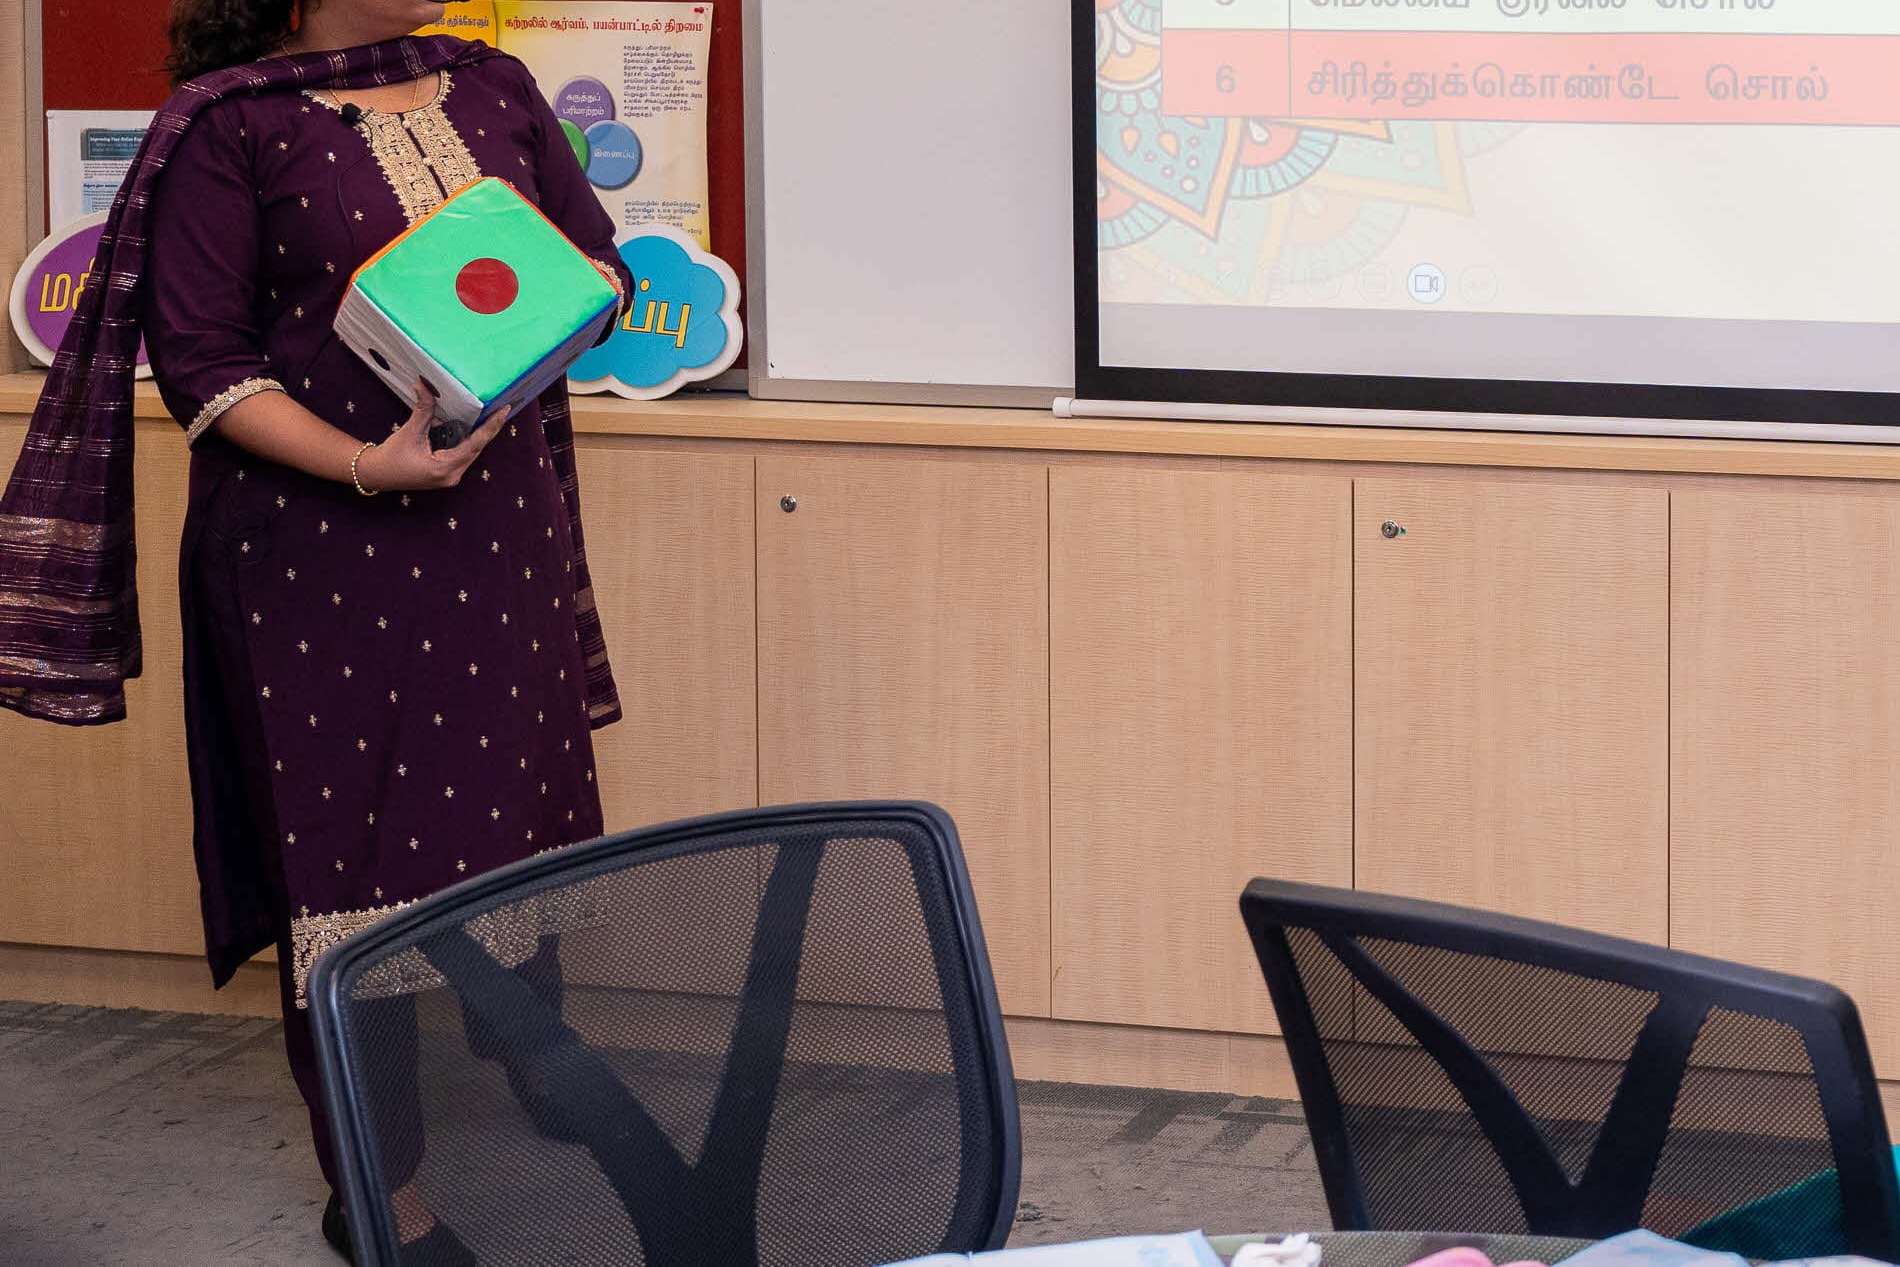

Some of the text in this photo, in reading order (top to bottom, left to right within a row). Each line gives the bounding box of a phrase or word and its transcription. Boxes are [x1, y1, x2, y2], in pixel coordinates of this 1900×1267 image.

[505, 16, 704, 34] கற்றலில் ஆர்வம், பயன்பாட்டில் திறமை
[1216, 63, 1237, 94] 6
[1307, 60, 1830, 107] சிரித்துக்கொண்டே சொல்
[562, 105, 605, 117] பரிமாற்றம்
